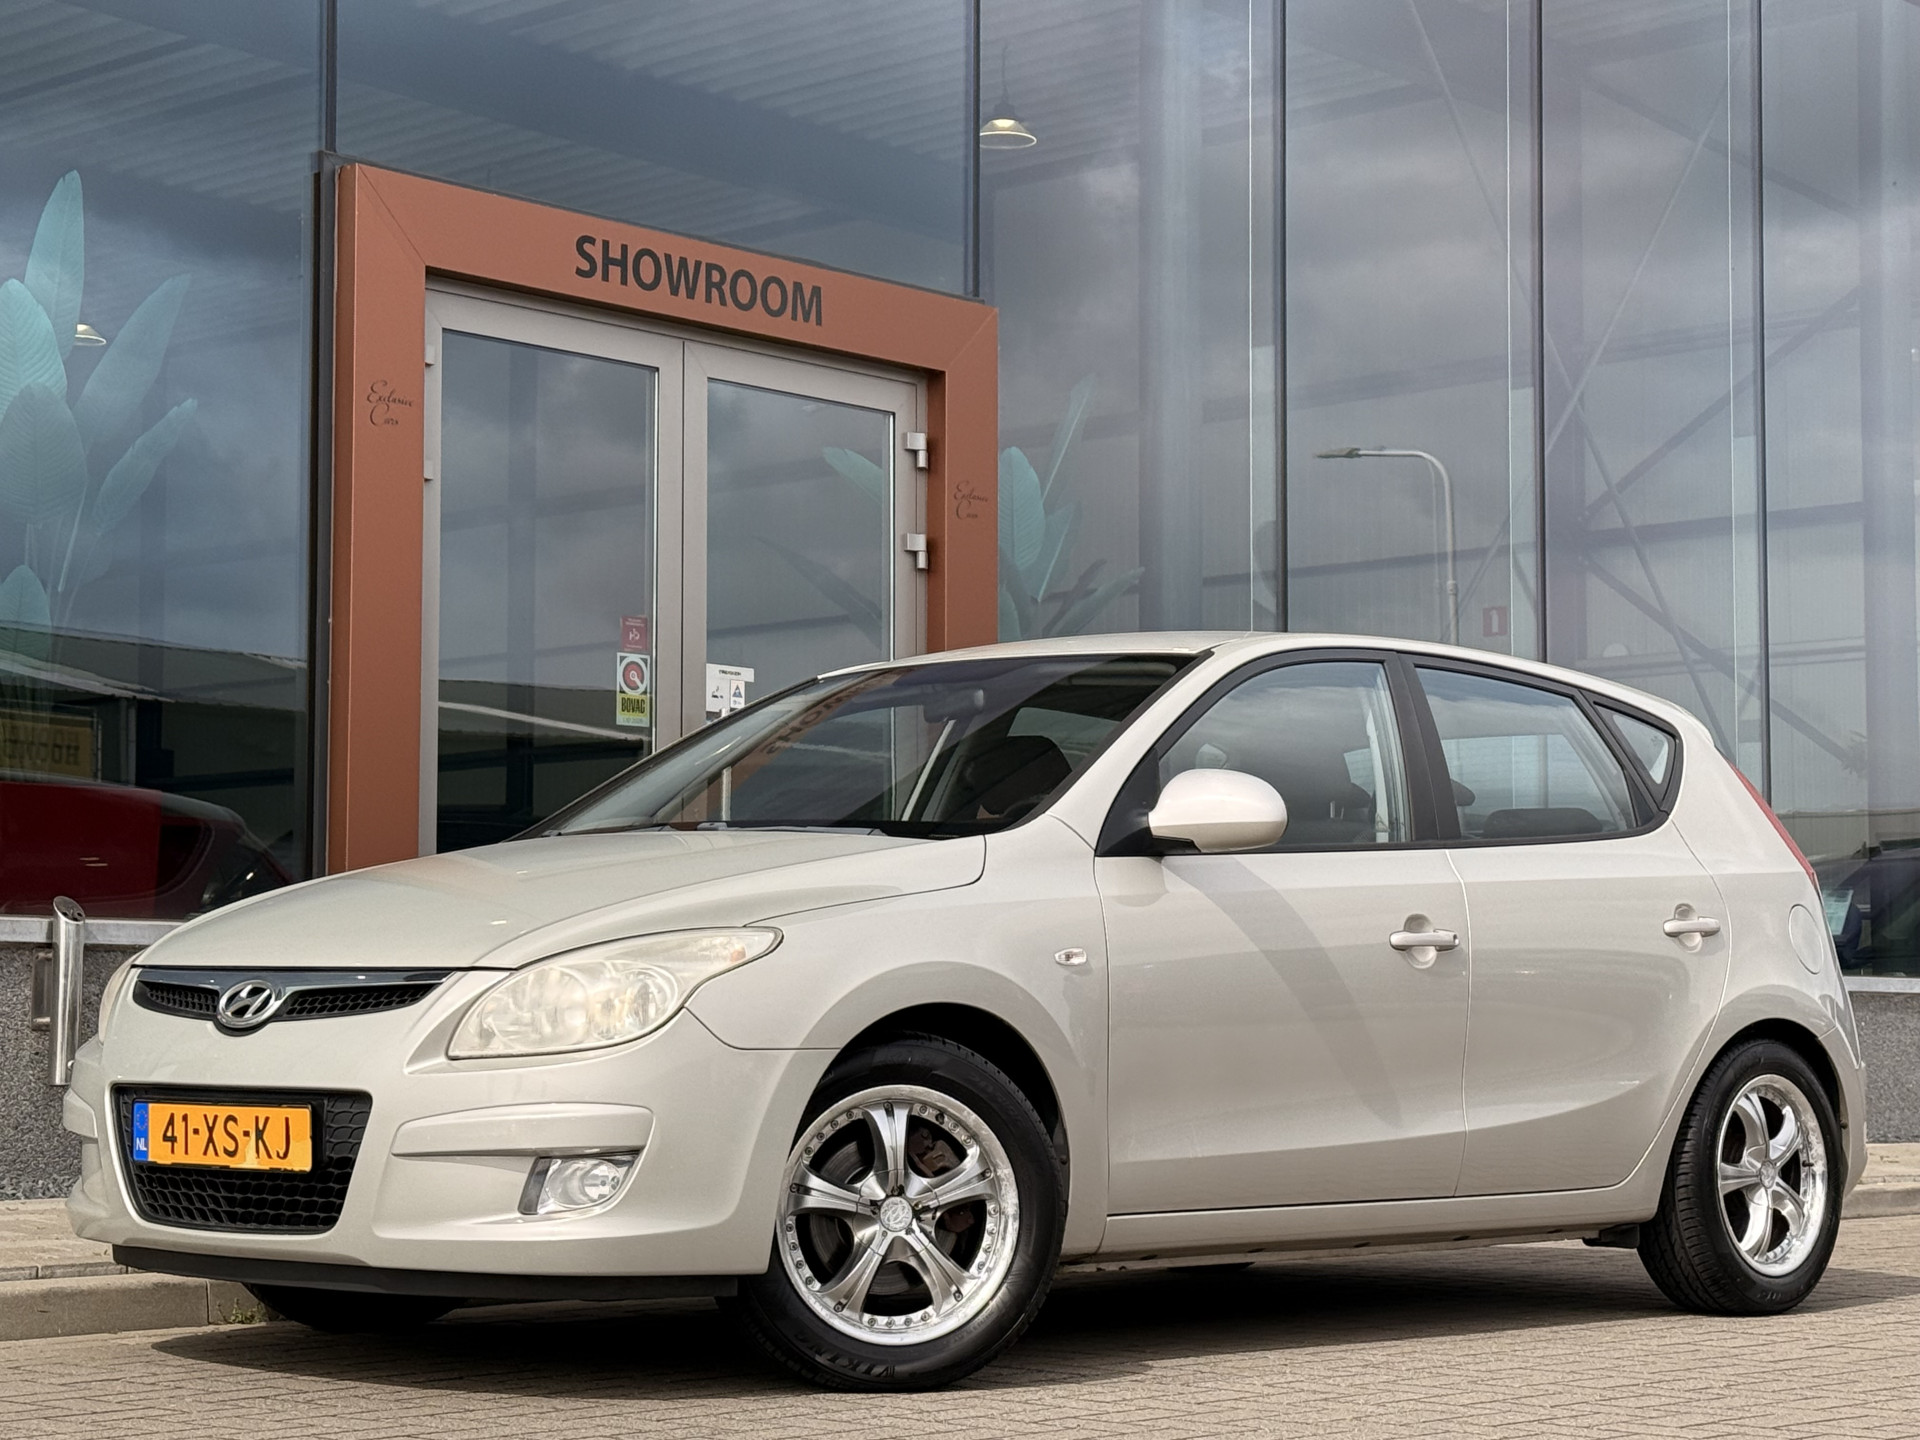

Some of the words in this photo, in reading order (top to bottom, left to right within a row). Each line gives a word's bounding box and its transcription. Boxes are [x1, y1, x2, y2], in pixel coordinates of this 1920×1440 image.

[575, 235, 823, 327] SHOWROOM
[621, 697, 646, 714] BOVAG
[136, 1137, 147, 1150] NL
[162, 1112, 291, 1160] 41-XS-KJ
